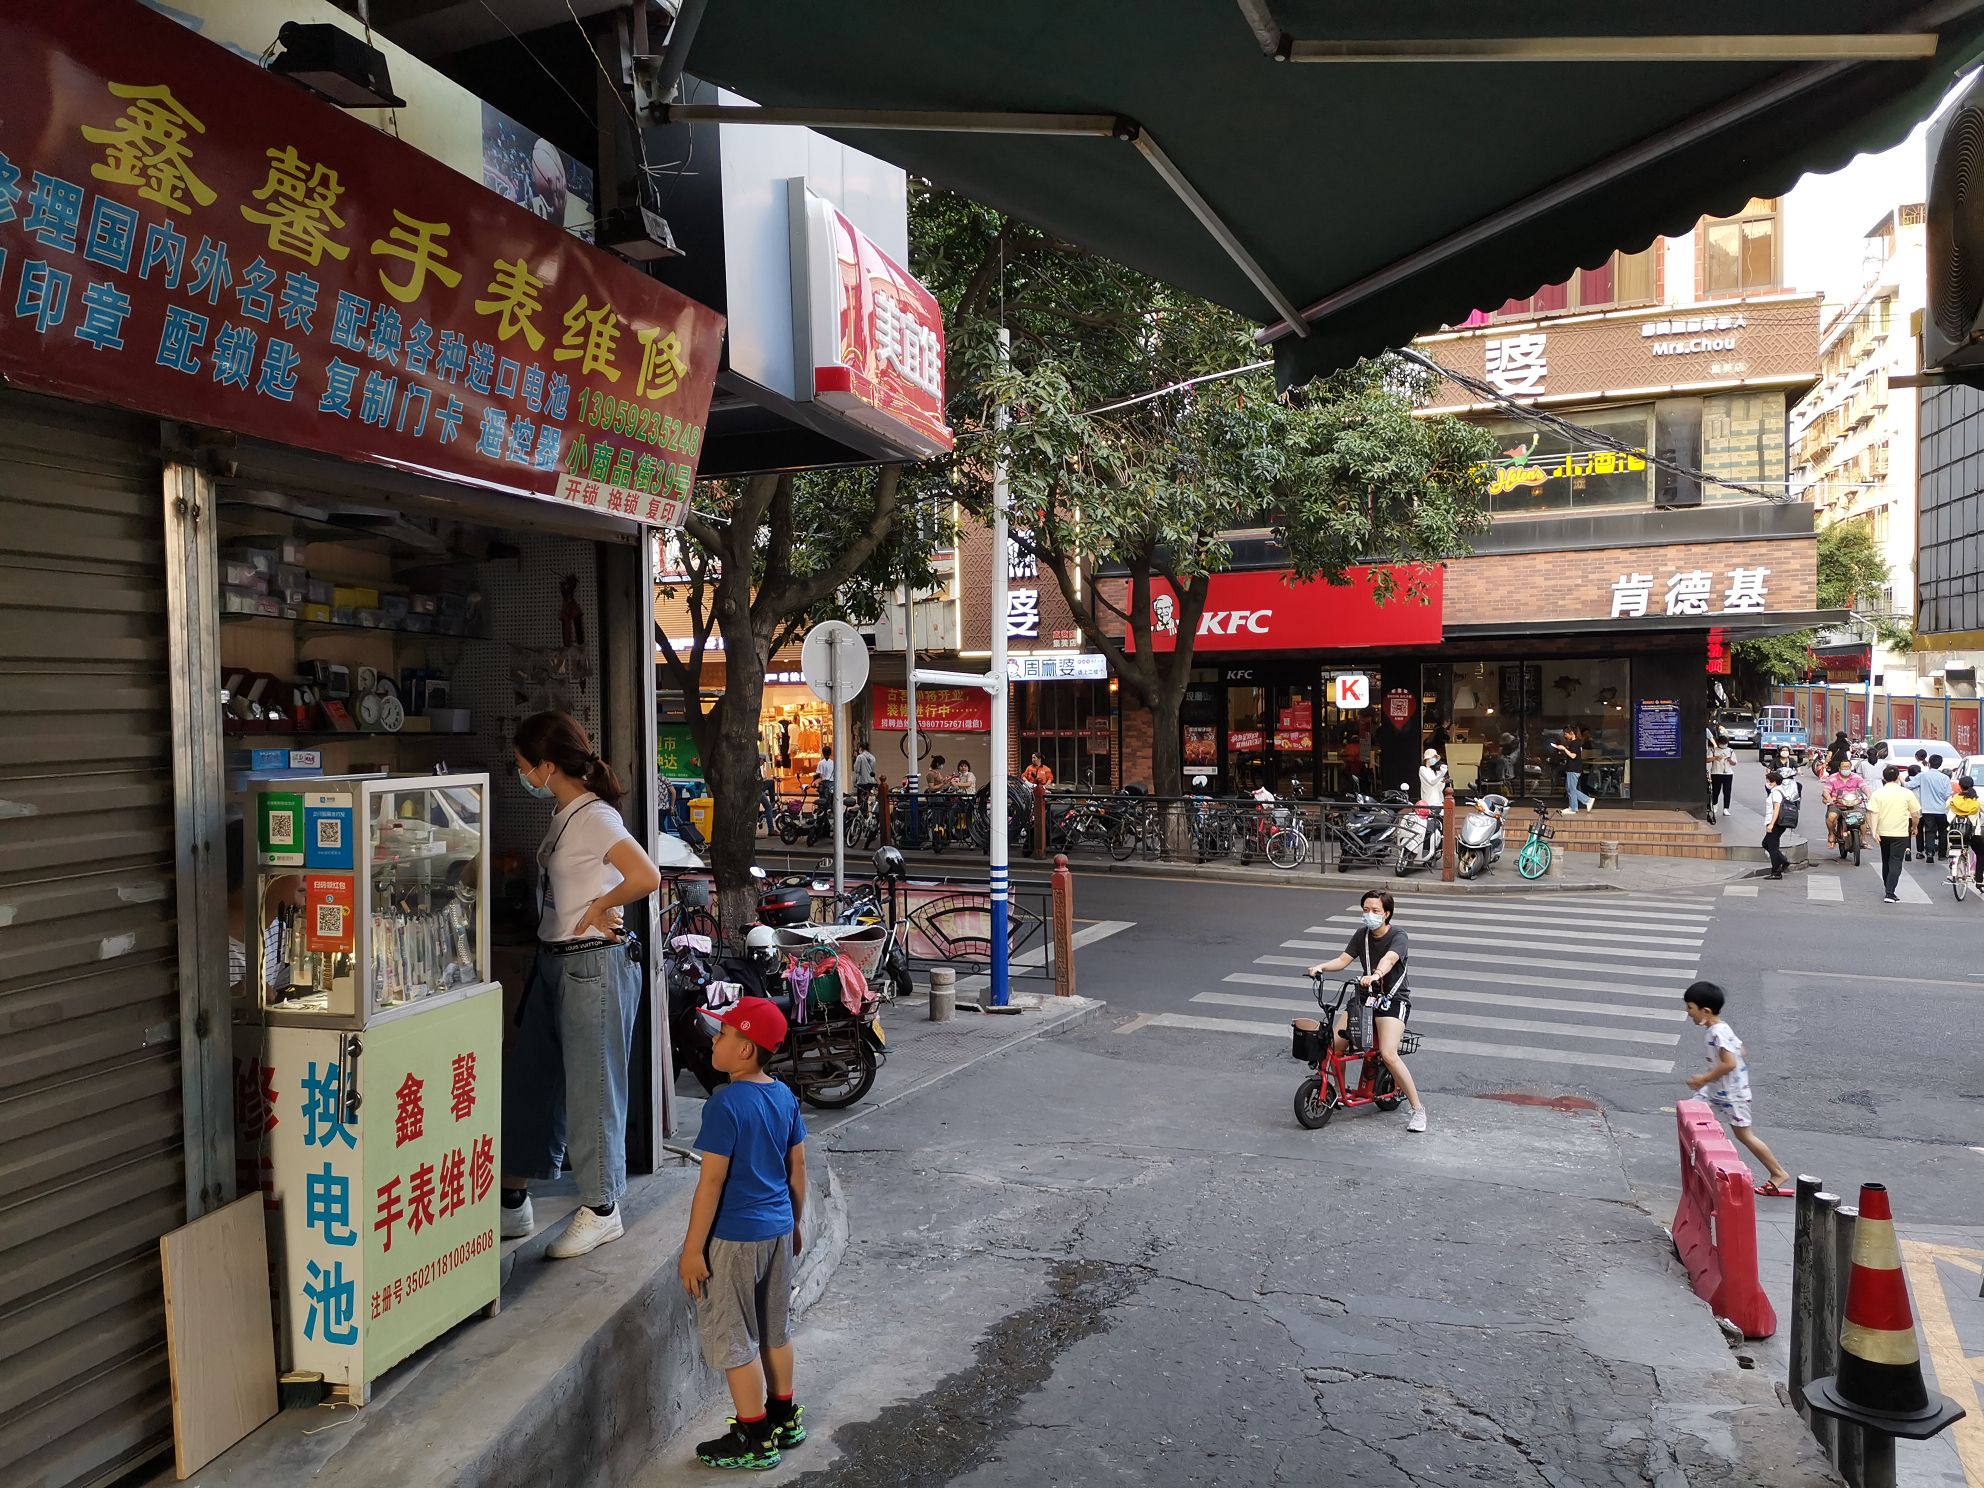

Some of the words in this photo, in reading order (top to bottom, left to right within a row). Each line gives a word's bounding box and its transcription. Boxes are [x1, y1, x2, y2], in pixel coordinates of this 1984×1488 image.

[81, 80, 688, 401] 鑫馨手表维修
[0, 248, 131, 351] 印章
[155, 305, 301, 402] 配锁匙
[318, 359, 463, 445] 复制门卡
[476, 408, 561, 473] 遥控器
[330, 289, 571, 421] 配换各种进口电池
[874, 291, 943, 400] 美宜佳
[1653, 337, 1736, 356] Mrs.Chou
[578, 386, 701, 457] 13959235248
[565, 434, 692, 502] 小商品街39号
[1488, 465, 1548, 495] Helen's
[565, 479, 600, 506] 开锁
[608, 488, 640, 515] 换锁
[646, 499, 676, 524] 复印
[1610, 567, 1773, 618] 肯德基
[1196, 609, 1273, 636] KFC
[1023, 658, 1075, 677] 周麻婆
[1227, 670, 1254, 680] KFC
[1341, 679, 1361, 701] K
[565, 943, 579, 951] LOUIS
[580, 940, 603, 949] VUITTON
[301, 1061, 359, 1346] 换电池
[374, 1132, 495, 1253] 手表维修
[370, 1277, 403, 1321] 注册号
[404, 1228, 494, 1297] 350211810034608
